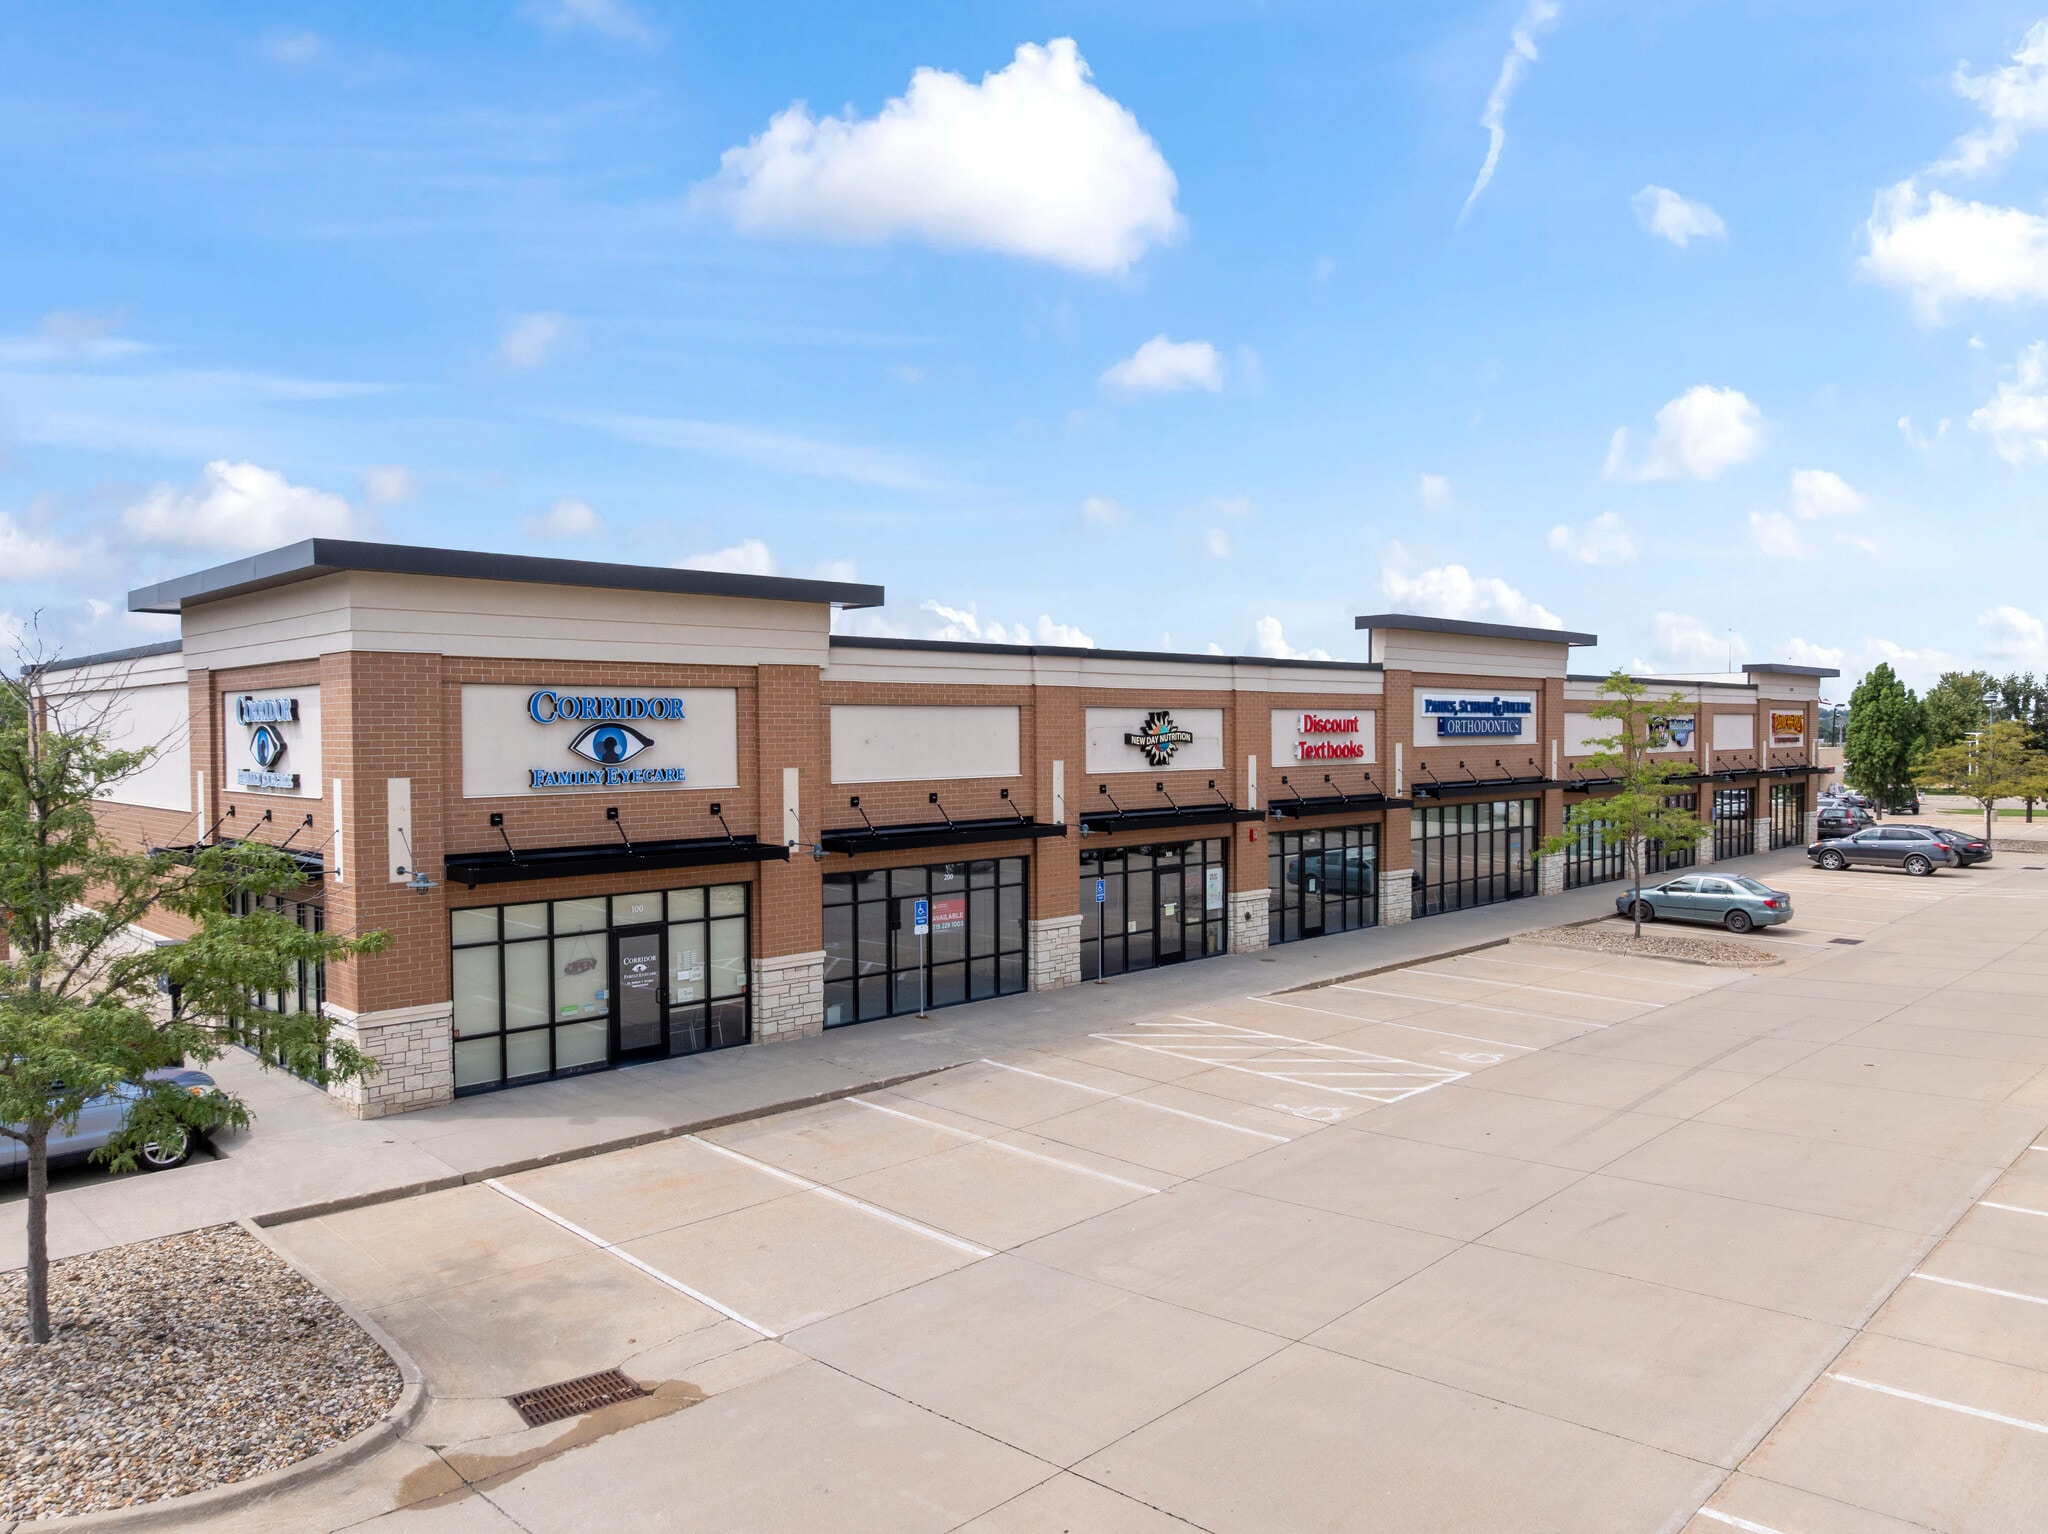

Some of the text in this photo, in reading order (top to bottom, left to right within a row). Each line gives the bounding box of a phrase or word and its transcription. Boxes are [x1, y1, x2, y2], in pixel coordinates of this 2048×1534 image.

[528, 690, 686, 724] CORRIDOR
[1303, 714, 1359, 733] Discount
[1447, 719, 1520, 733] ORTHODONTICS
[1131, 732, 1191, 745] NEW DAY NUTRITION
[1298, 740, 1364, 760] Textbooks
[530, 767, 686, 788] FAMILY EYECARE
[943, 873, 954, 881] 200
[631, 904, 644, 913] 100
[932, 911, 964, 922] AVAILABLE
[623, 955, 657, 966] CORRIDOR
